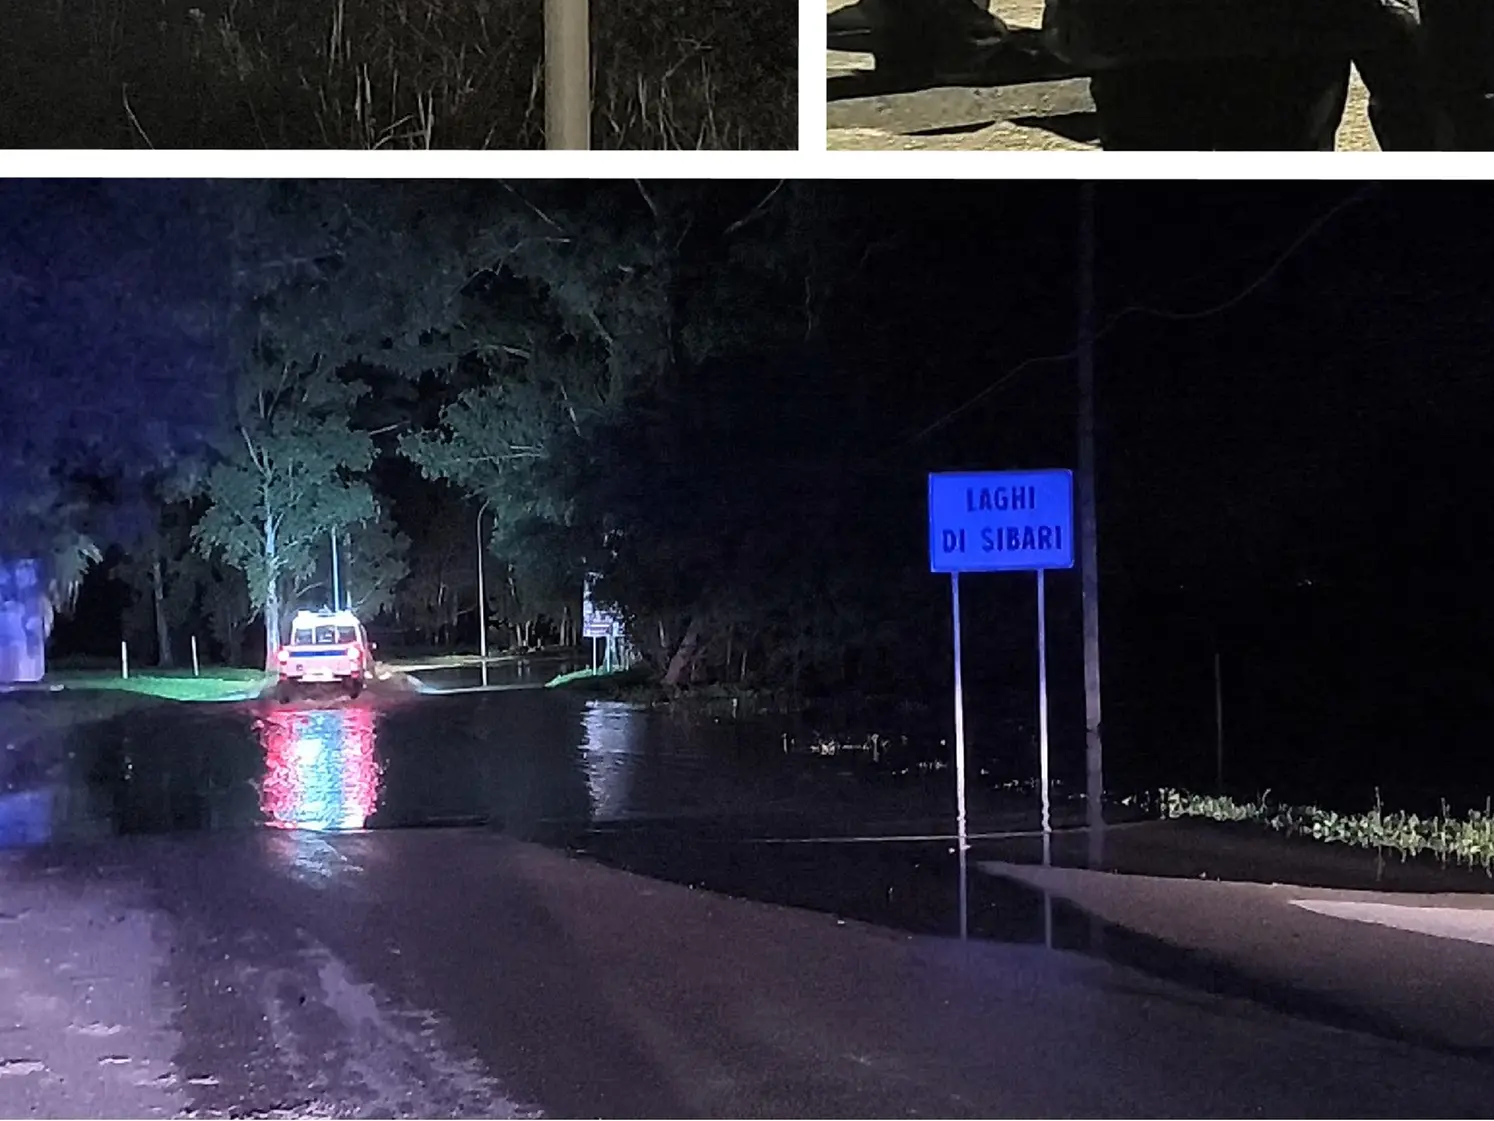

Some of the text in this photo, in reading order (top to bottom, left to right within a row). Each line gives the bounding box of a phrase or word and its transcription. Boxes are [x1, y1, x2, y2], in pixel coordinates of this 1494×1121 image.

[966, 486, 1035, 512] LAGHI
[942, 525, 1063, 554] DI SIBARI
